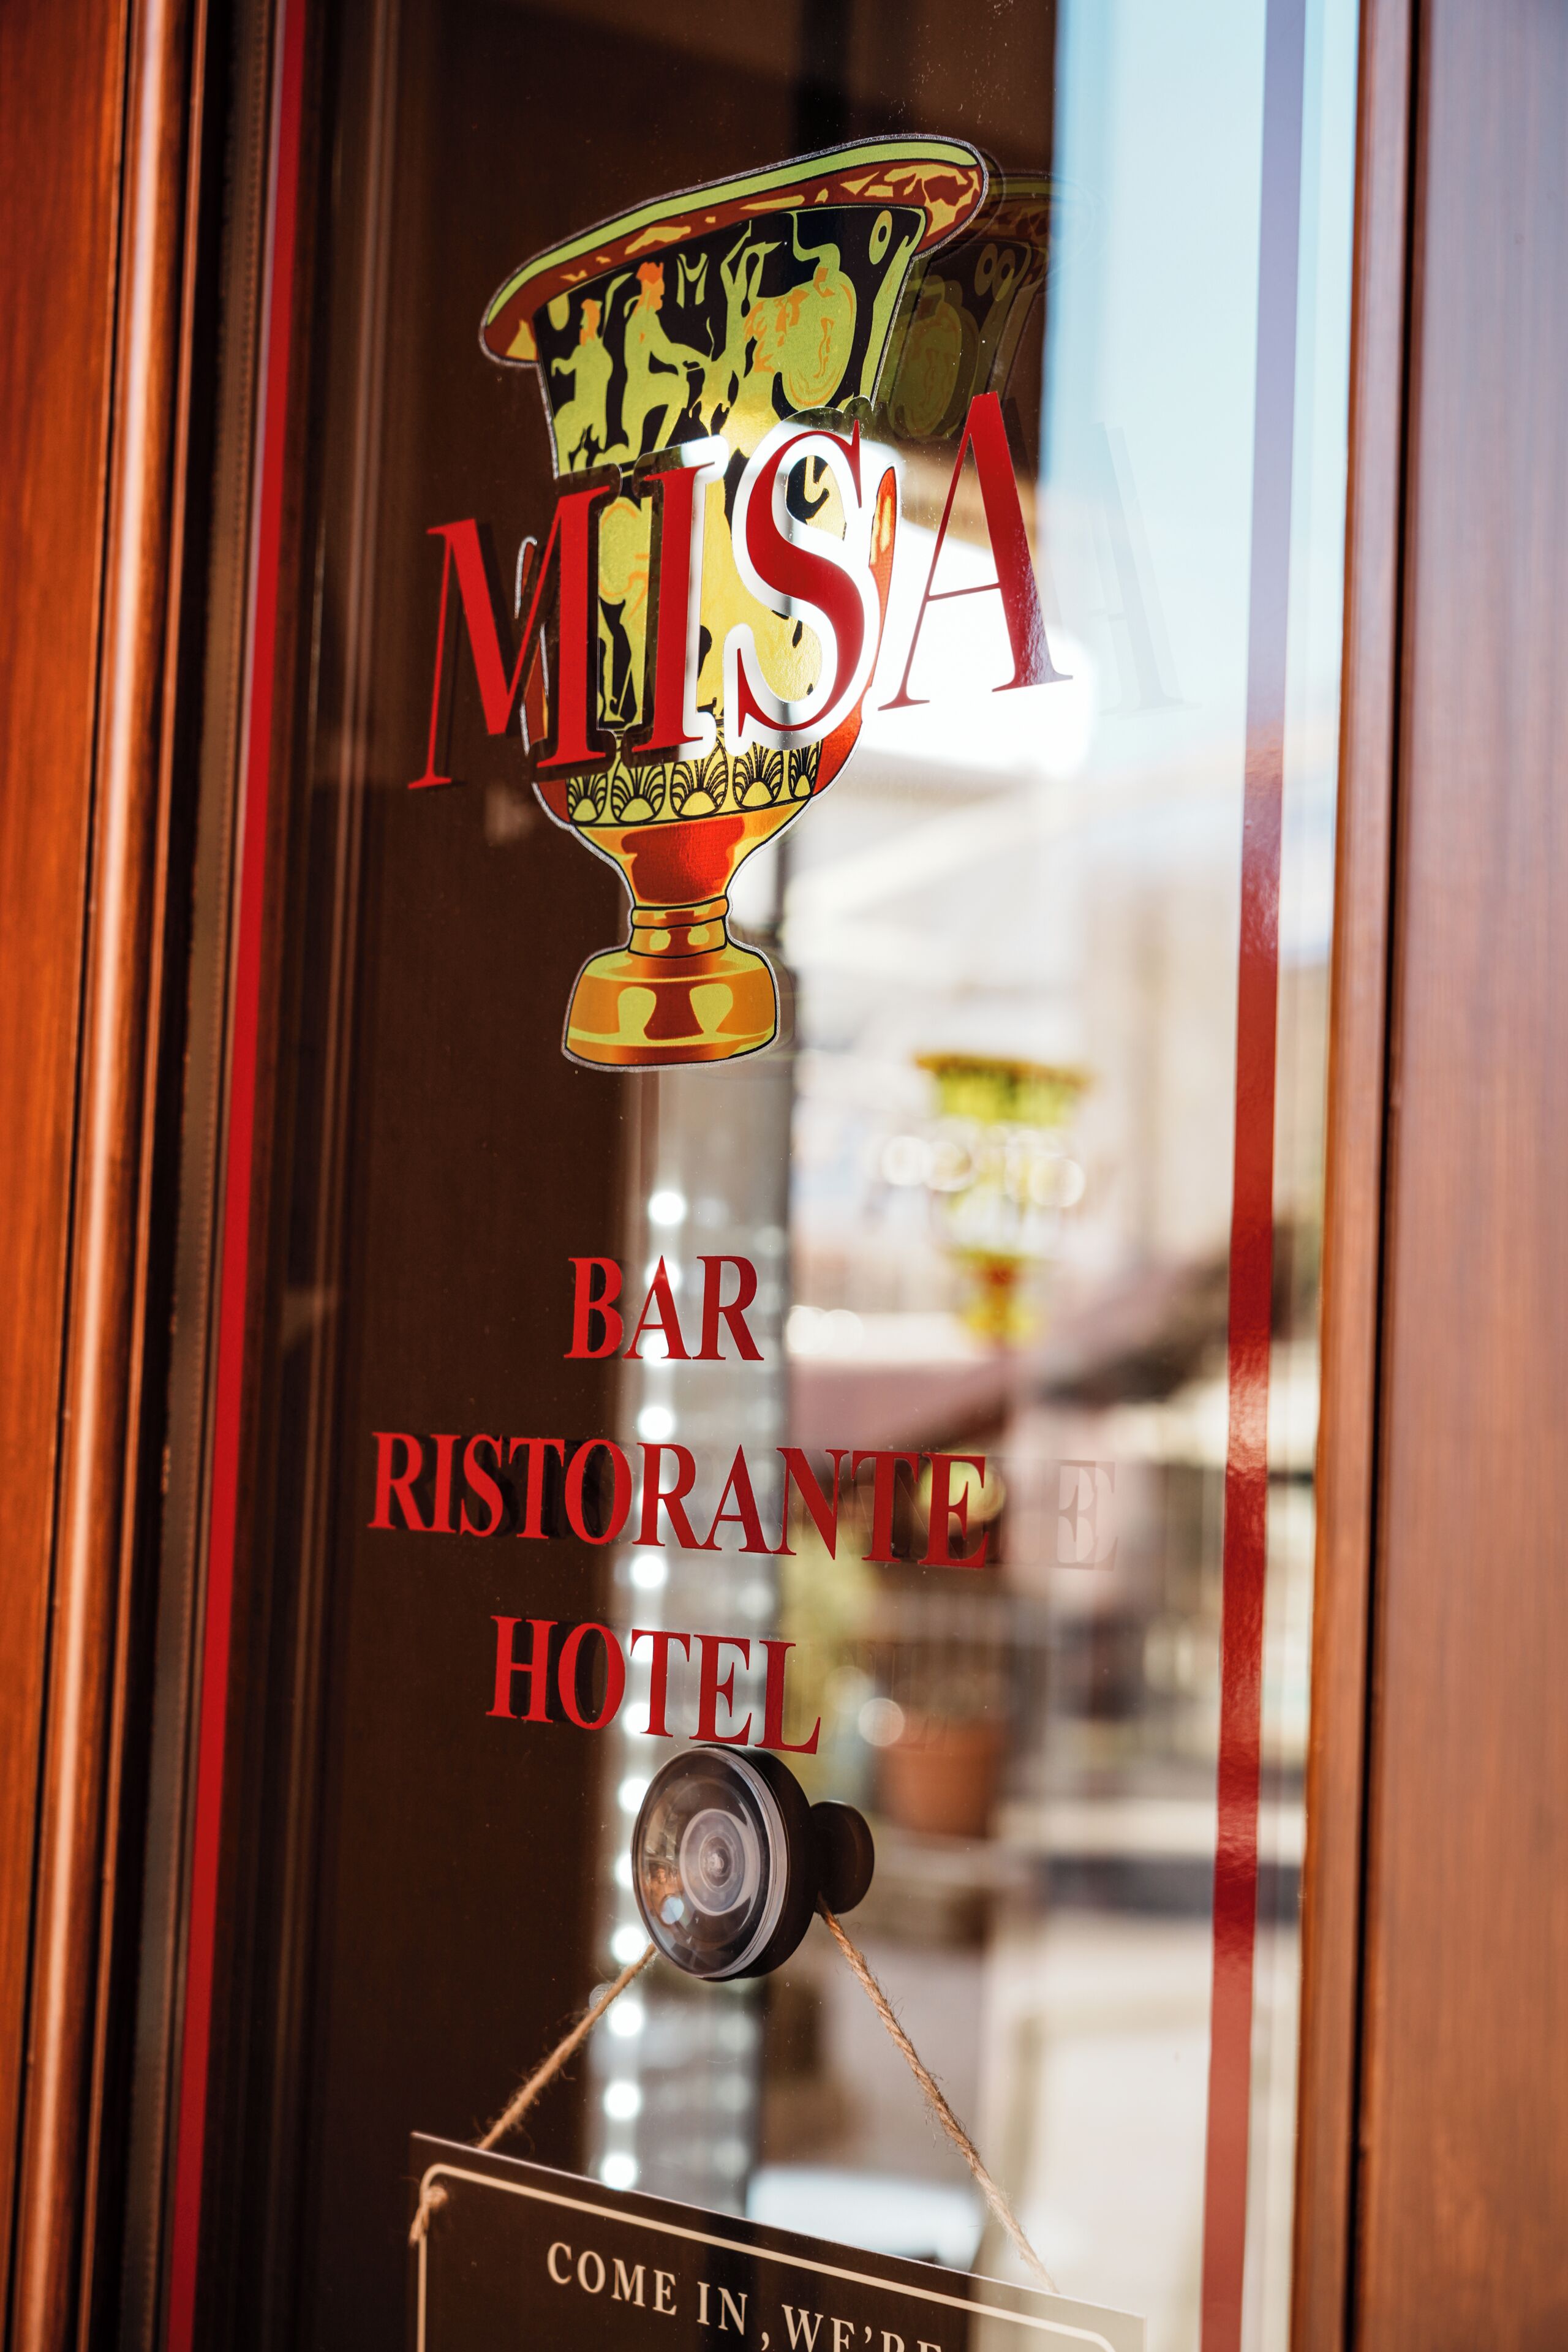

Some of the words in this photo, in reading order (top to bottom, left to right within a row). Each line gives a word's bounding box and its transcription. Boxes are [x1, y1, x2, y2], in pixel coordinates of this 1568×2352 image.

[408, 391, 1074, 790] MISA
[564, 1255, 764, 1361] BAR
[368, 1431, 988, 1568] RISTORANTE
[485, 1615, 821, 1754] HOTEL
[547, 2242, 677, 2315] COME
[782, 2304, 941, 2352] WE'
